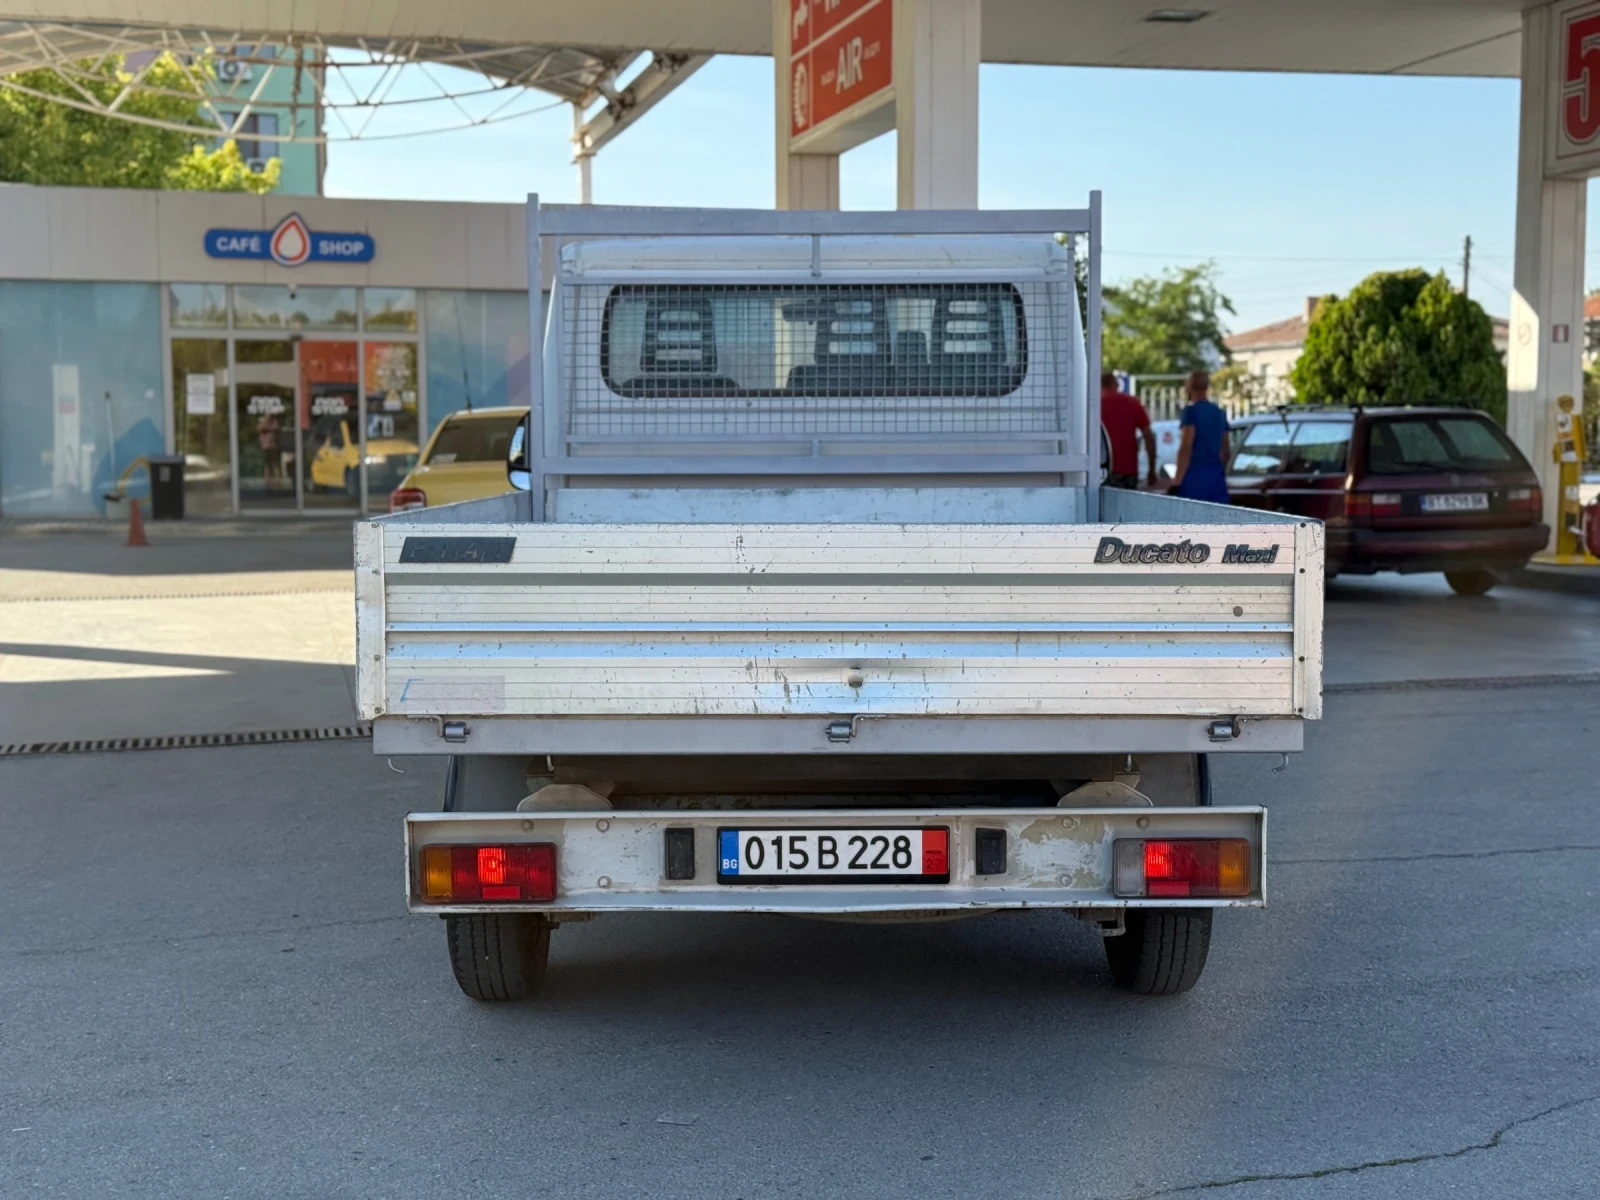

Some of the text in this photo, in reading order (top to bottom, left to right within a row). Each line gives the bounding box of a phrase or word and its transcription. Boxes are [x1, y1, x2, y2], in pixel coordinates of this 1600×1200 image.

[835, 36, 863, 95] AIR
[216, 236, 365, 256] CAFÉ SHOP
[1094, 536, 1280, 564] Ducato Maxi
[722, 858, 738, 870] BG
[744, 835, 913, 871] 015 B 228
